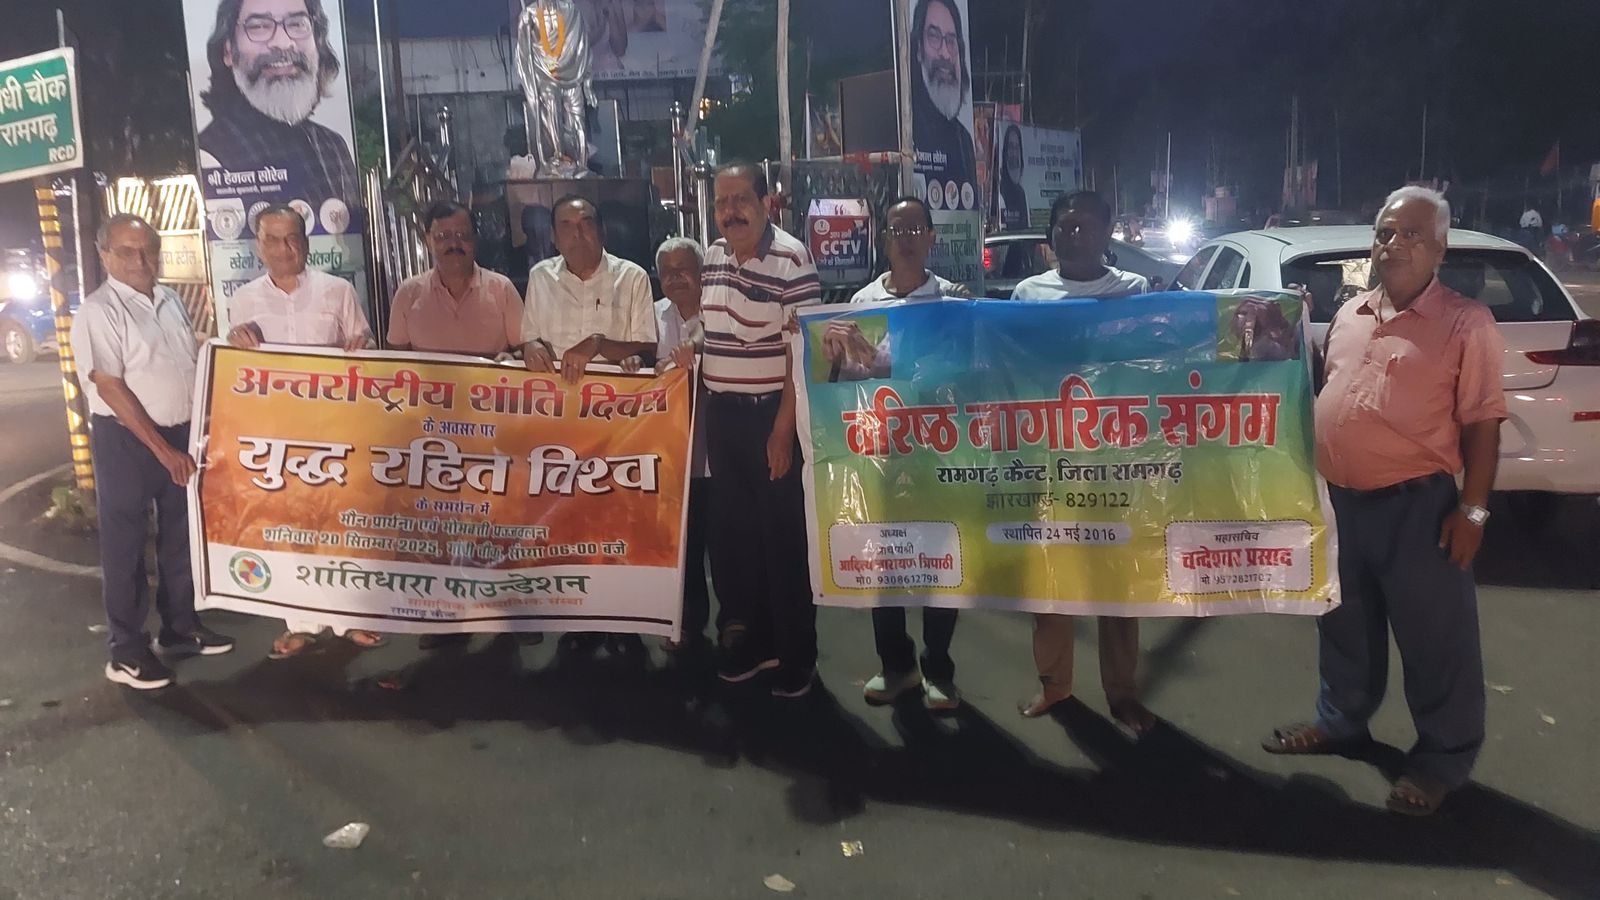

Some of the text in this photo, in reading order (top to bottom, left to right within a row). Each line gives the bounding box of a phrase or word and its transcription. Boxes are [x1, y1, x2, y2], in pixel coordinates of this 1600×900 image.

[0, 69, 67, 114] धी चौक
[0, 113, 59, 147] रामगढ़
[49, 145, 76, 162] RCD
[223, 169, 255, 185] हेमन्त
[257, 166, 288, 182] सोरेन
[820, 240, 861, 256] CCTV
[470, 376, 565, 417] शांति
[1157, 370, 1280, 447] संगम
[423, 416, 496, 437] के अवसर पर
[237, 435, 661, 496] युद्ध रहित विश्व
[936, 466, 998, 487] रामगढ़
[1057, 457, 1107, 482] जिला
[1112, 462, 1183, 484] रामगढ़
[416, 497, 427, 511] के
[479, 502, 490, 515] में
[1066, 492, 1130, 508] 829122
[340, 511, 367, 526] मौन
[263, 527, 315, 542] शनिवार
[319, 533, 339, 544] 20
[602, 540, 627, 555] बजे
[1002, 523, 1116, 542] स्थापित 24 मई 2016
[1213, 530, 1260, 544] महासचिव
[919, 552, 953, 570] त्रिपाठी
[296, 560, 591, 599] शांतिधारा फाउन्डेशन
[877, 573, 939, 584] 9308612798
